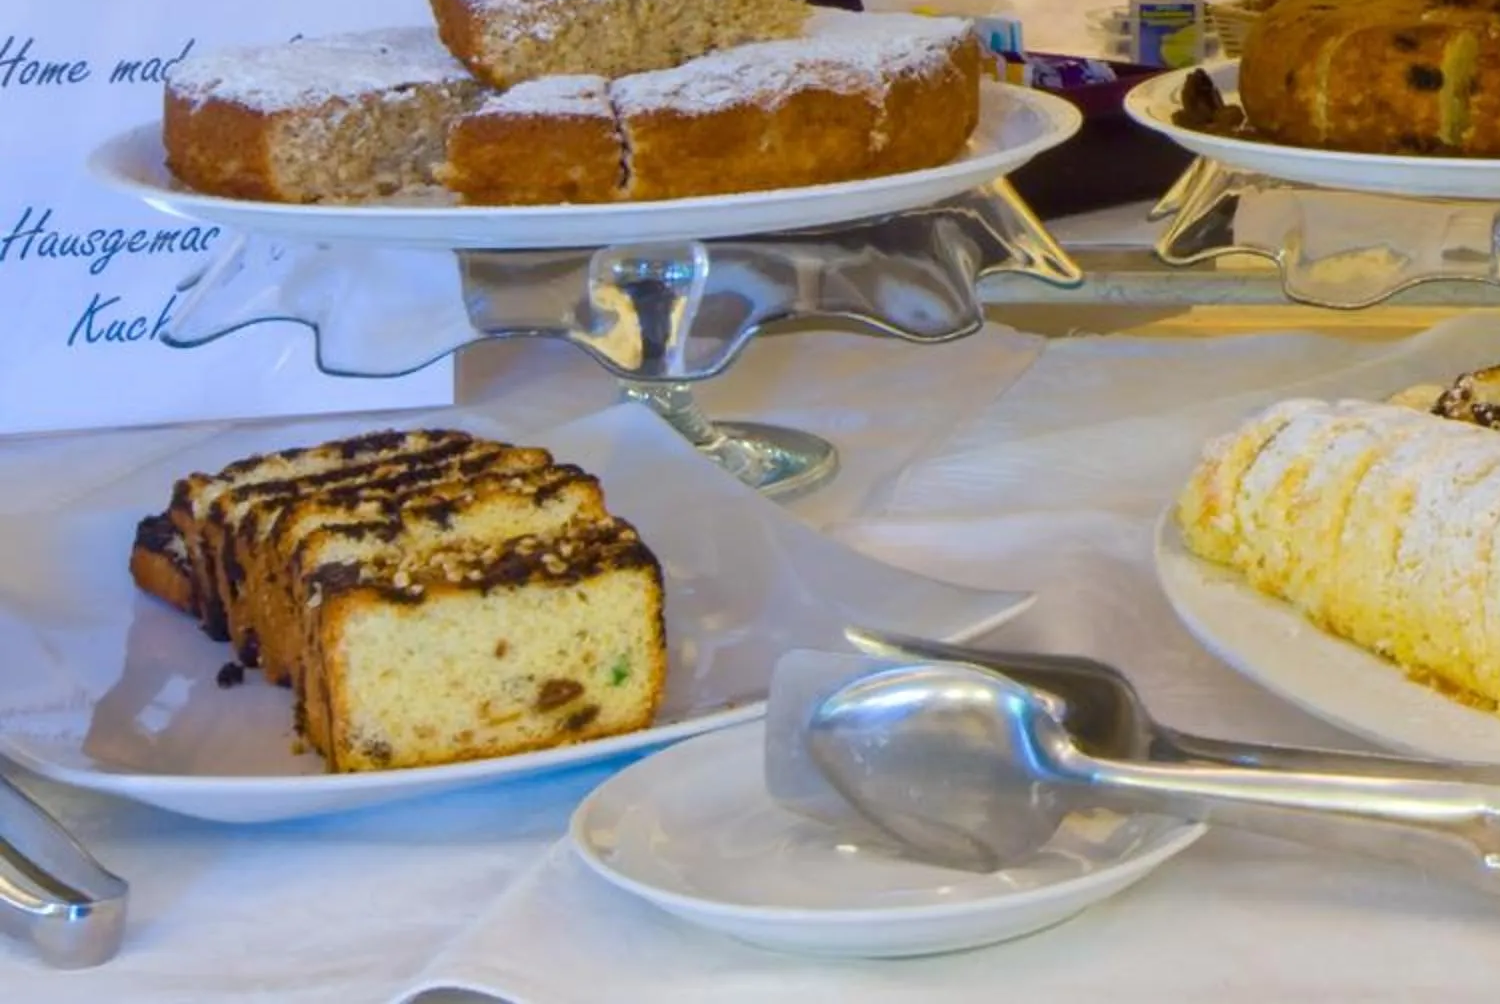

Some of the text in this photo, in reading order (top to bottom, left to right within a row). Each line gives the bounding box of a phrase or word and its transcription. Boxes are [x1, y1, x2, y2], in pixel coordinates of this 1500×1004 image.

[0, 35, 196, 88] Home mad
[0, 206, 221, 276] Hausgemac
